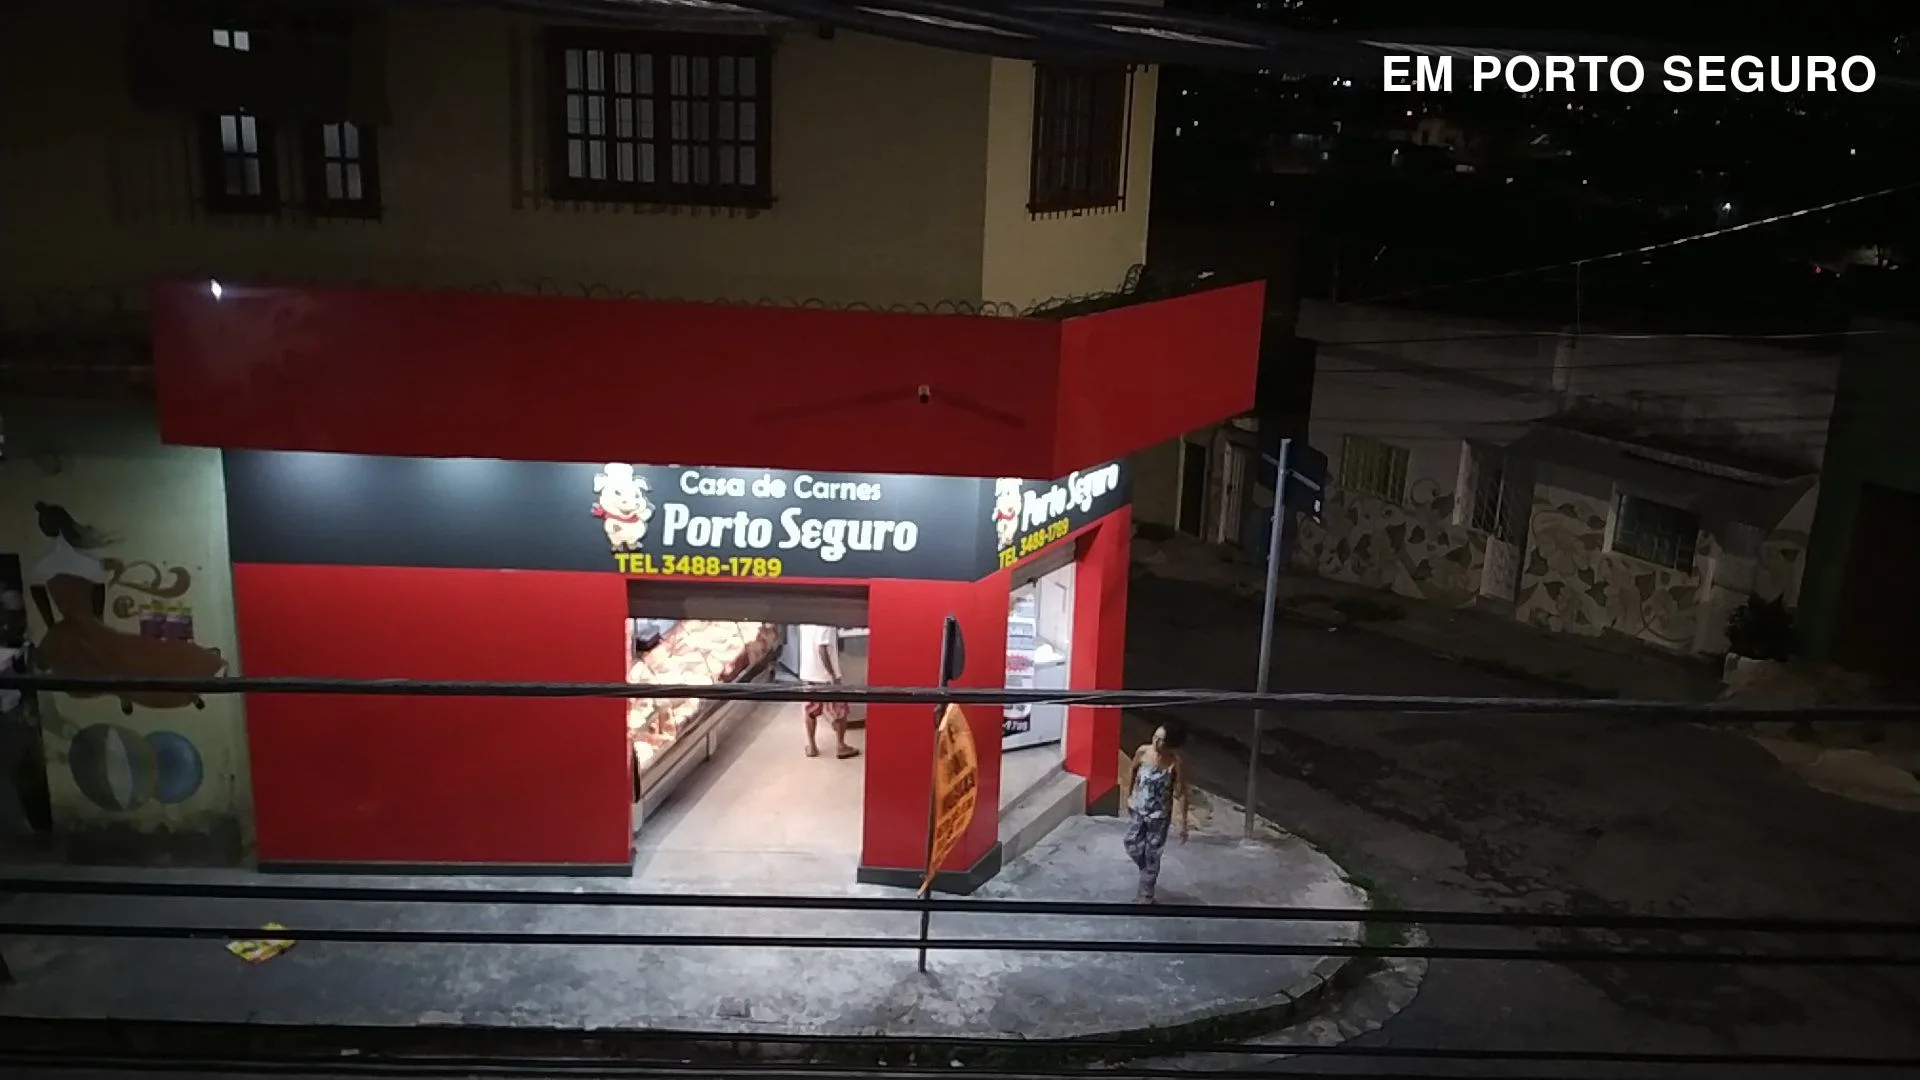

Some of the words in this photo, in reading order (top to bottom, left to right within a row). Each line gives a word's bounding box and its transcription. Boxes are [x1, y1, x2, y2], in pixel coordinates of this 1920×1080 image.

[680, 470, 746, 497] Casa
[752, 473, 787, 499] de
[793, 474, 881, 501] Carnes
[1021, 484, 1067, 532] Porto
[1066, 463, 1120, 513] Seguro
[663, 502, 773, 549] Porto
[779, 506, 919, 562] Seguro
[615, 552, 659, 574] TEL
[661, 554, 783, 579] 3488-1789
[999, 545, 1018, 569] TEL
